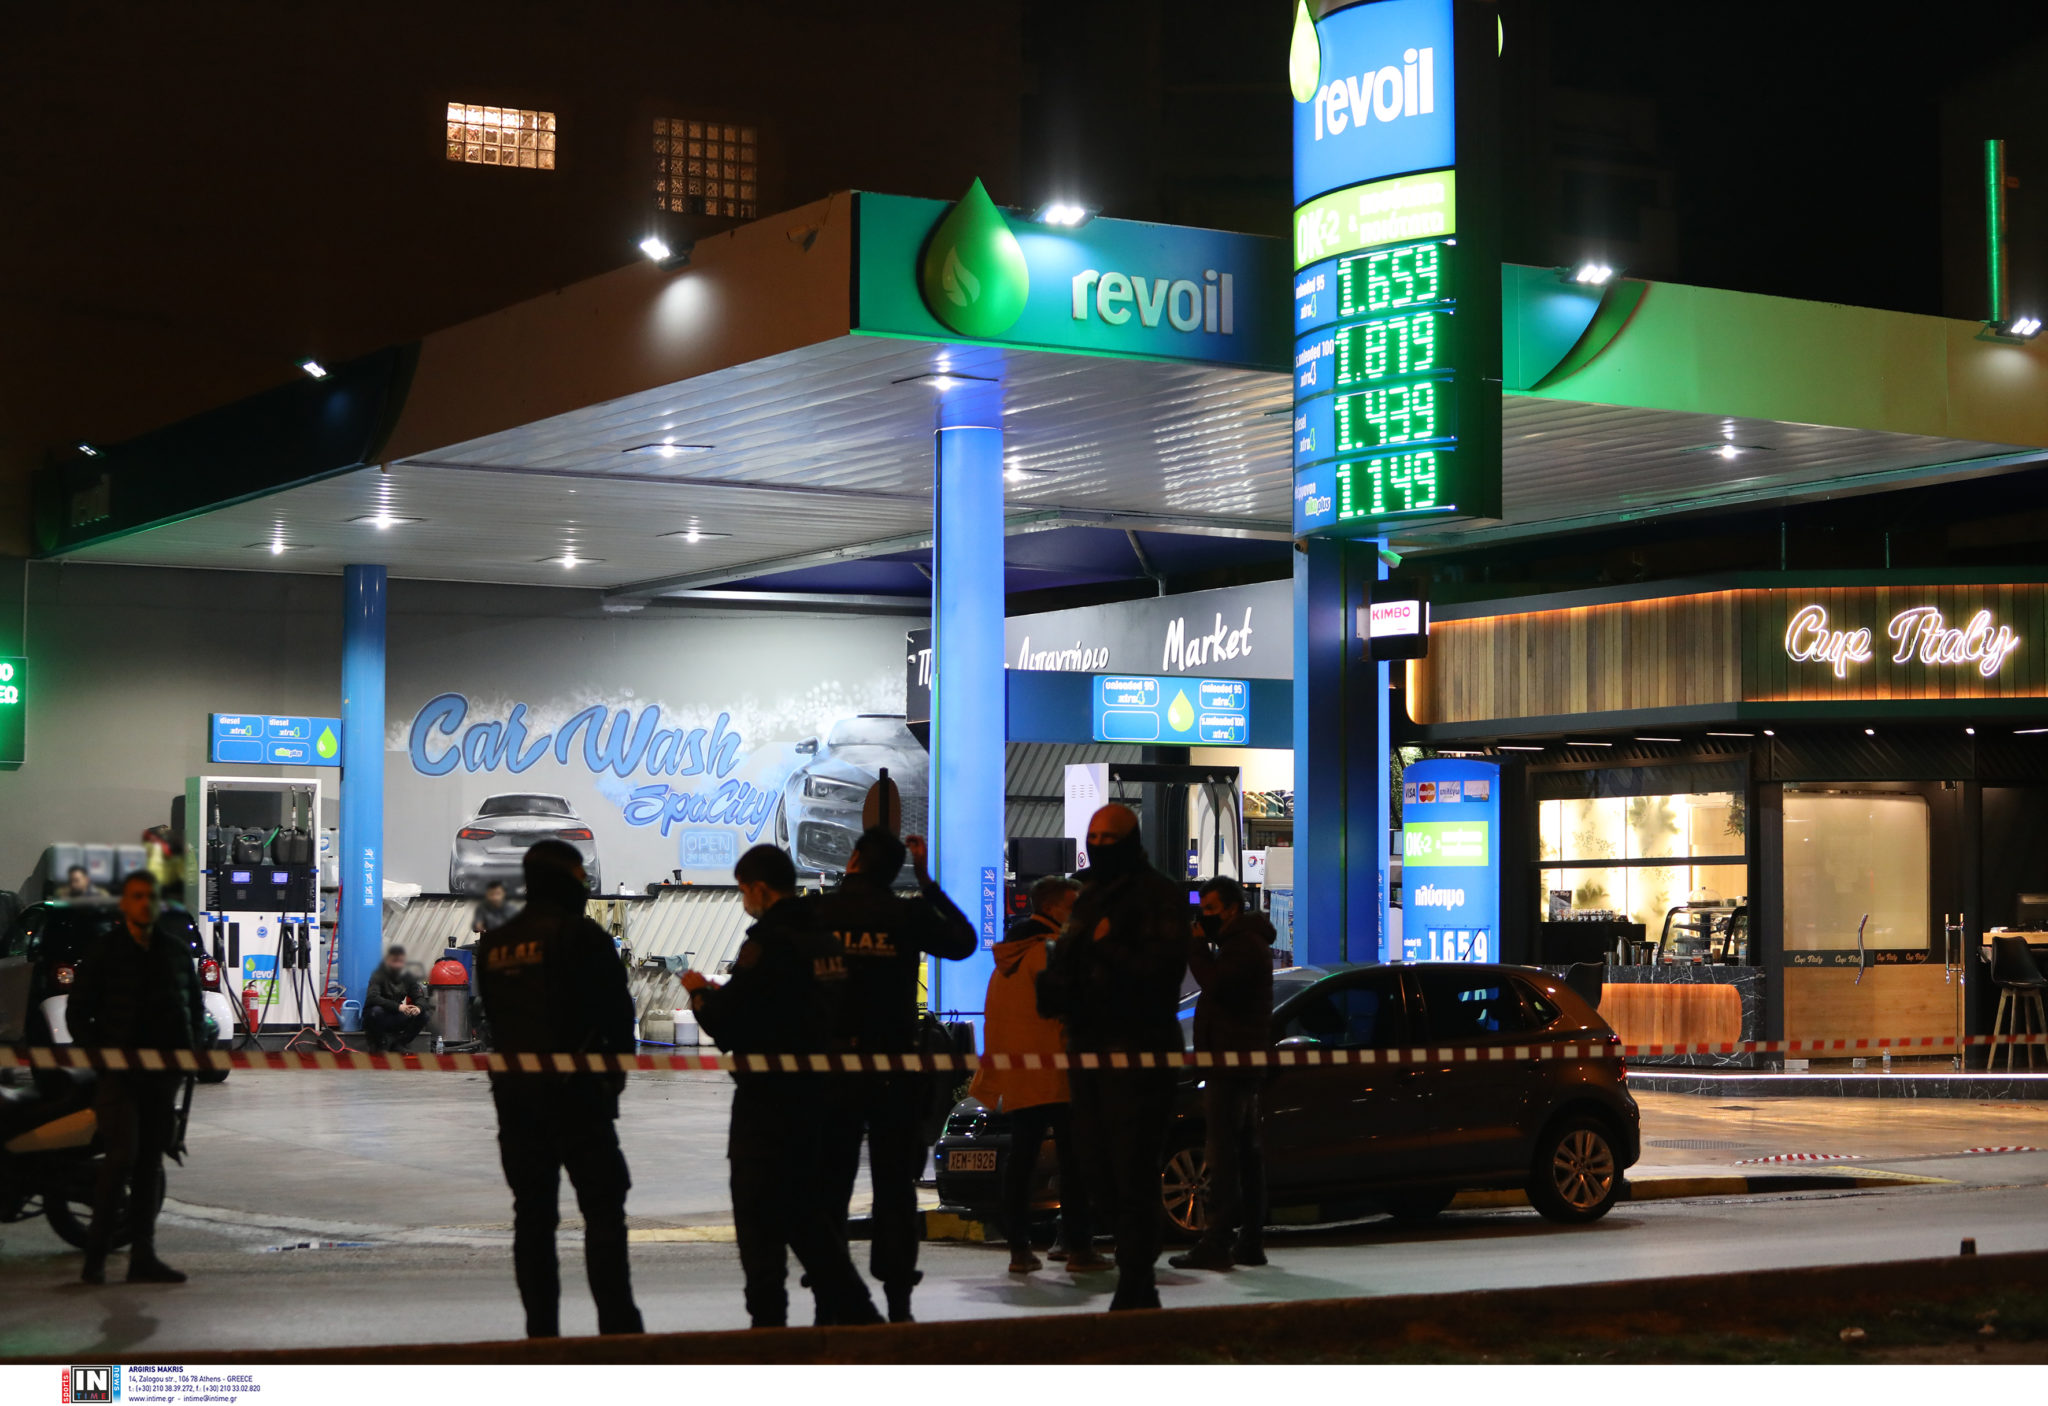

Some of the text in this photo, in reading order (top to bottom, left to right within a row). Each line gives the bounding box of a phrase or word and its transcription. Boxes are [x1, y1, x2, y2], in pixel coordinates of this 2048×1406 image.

[1315, 47, 1434, 141] revoil
[1072, 269, 1234, 335] revoil
[1337, 244, 1437, 316] 1.659
[1322, 339, 1334, 356] 100
[1334, 312, 1434, 385] 1.879
[1334, 382, 1434, 452] 1.439
[1336, 451, 1435, 518] 1.149
[1163, 606, 1253, 672] Market
[1372, 606, 1411, 621] KIMBO
[1785, 604, 2020, 678] Cup Italy
[408, 692, 742, 779] Car Wash
[686, 835, 730, 851] OPEN
